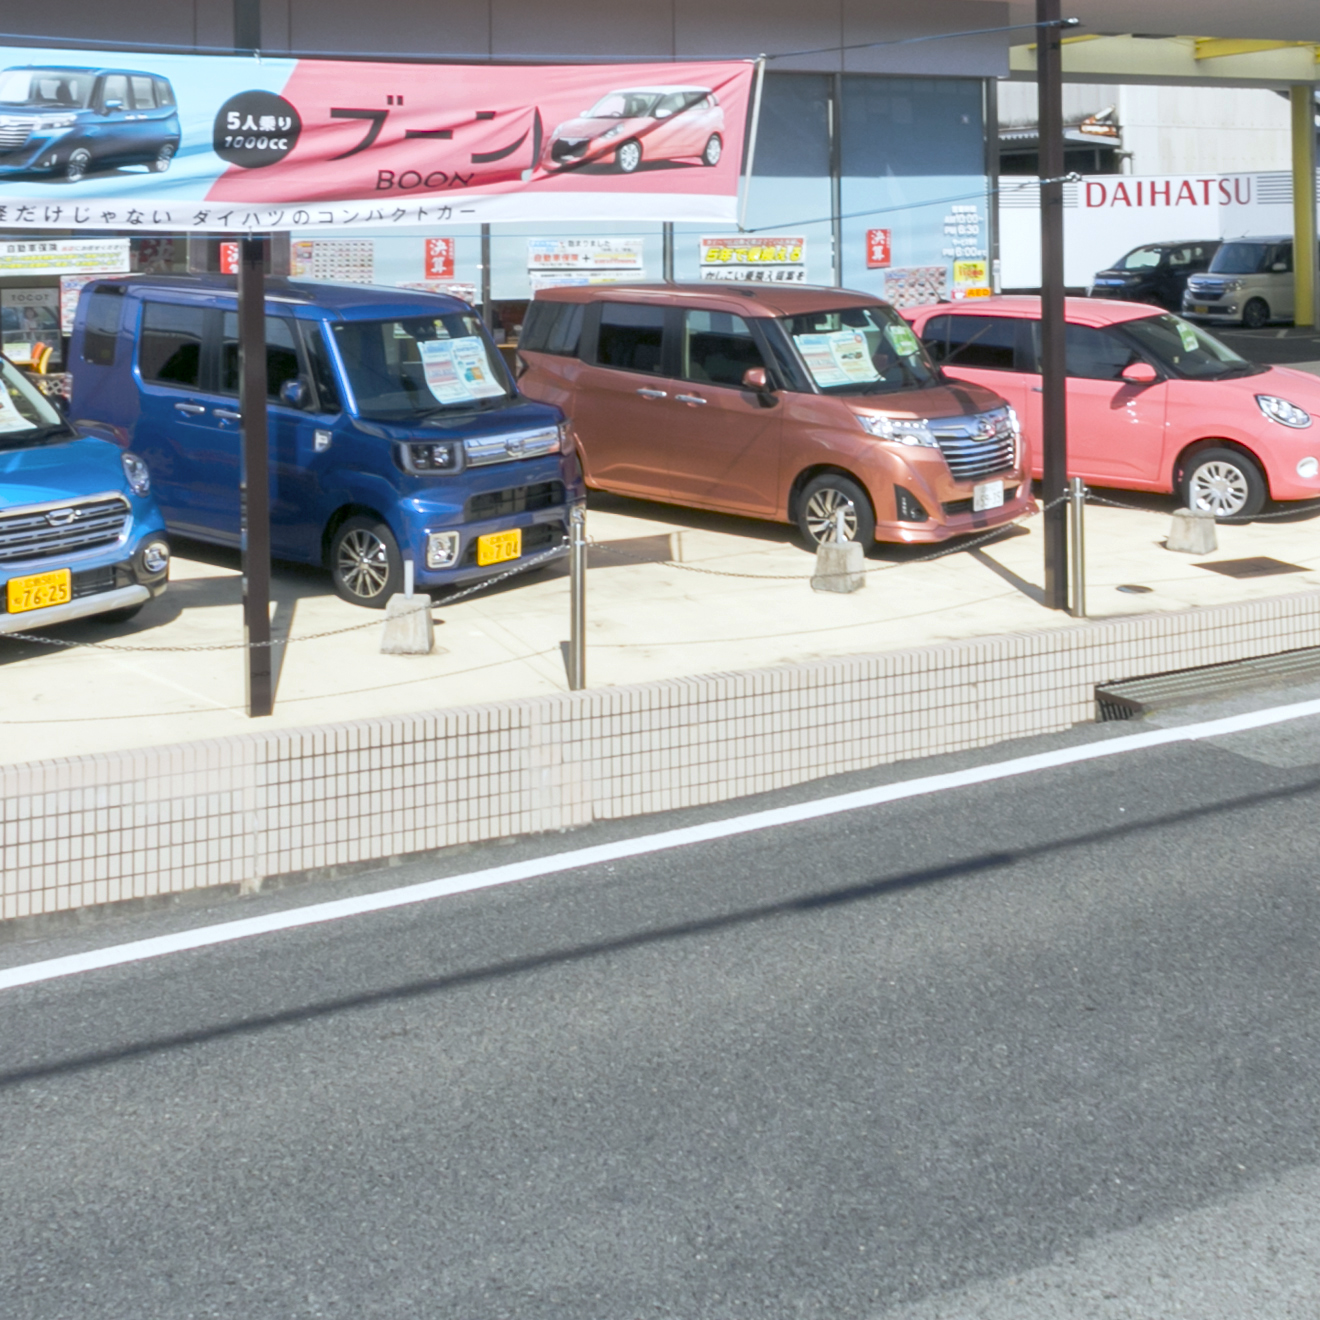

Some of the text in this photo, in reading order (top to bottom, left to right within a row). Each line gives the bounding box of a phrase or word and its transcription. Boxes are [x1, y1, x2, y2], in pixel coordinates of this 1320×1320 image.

[226, 110, 292, 131] 5人乗り
[327, 95, 532, 164] ブーン
[224, 135, 288, 150] 1000cc
[375, 169, 475, 191] BOON
[1085, 177, 1251, 208] DAIHATSU
[192, 204, 477, 227] ダイハツのコンパクトカー
[429, 239, 448, 274] 決算
[870, 229, 887, 262] 決算
[11, 293, 50, 302] TOCOT
[966, 287, 991, 297] AED
[23, 583, 67, 607] 76-25
